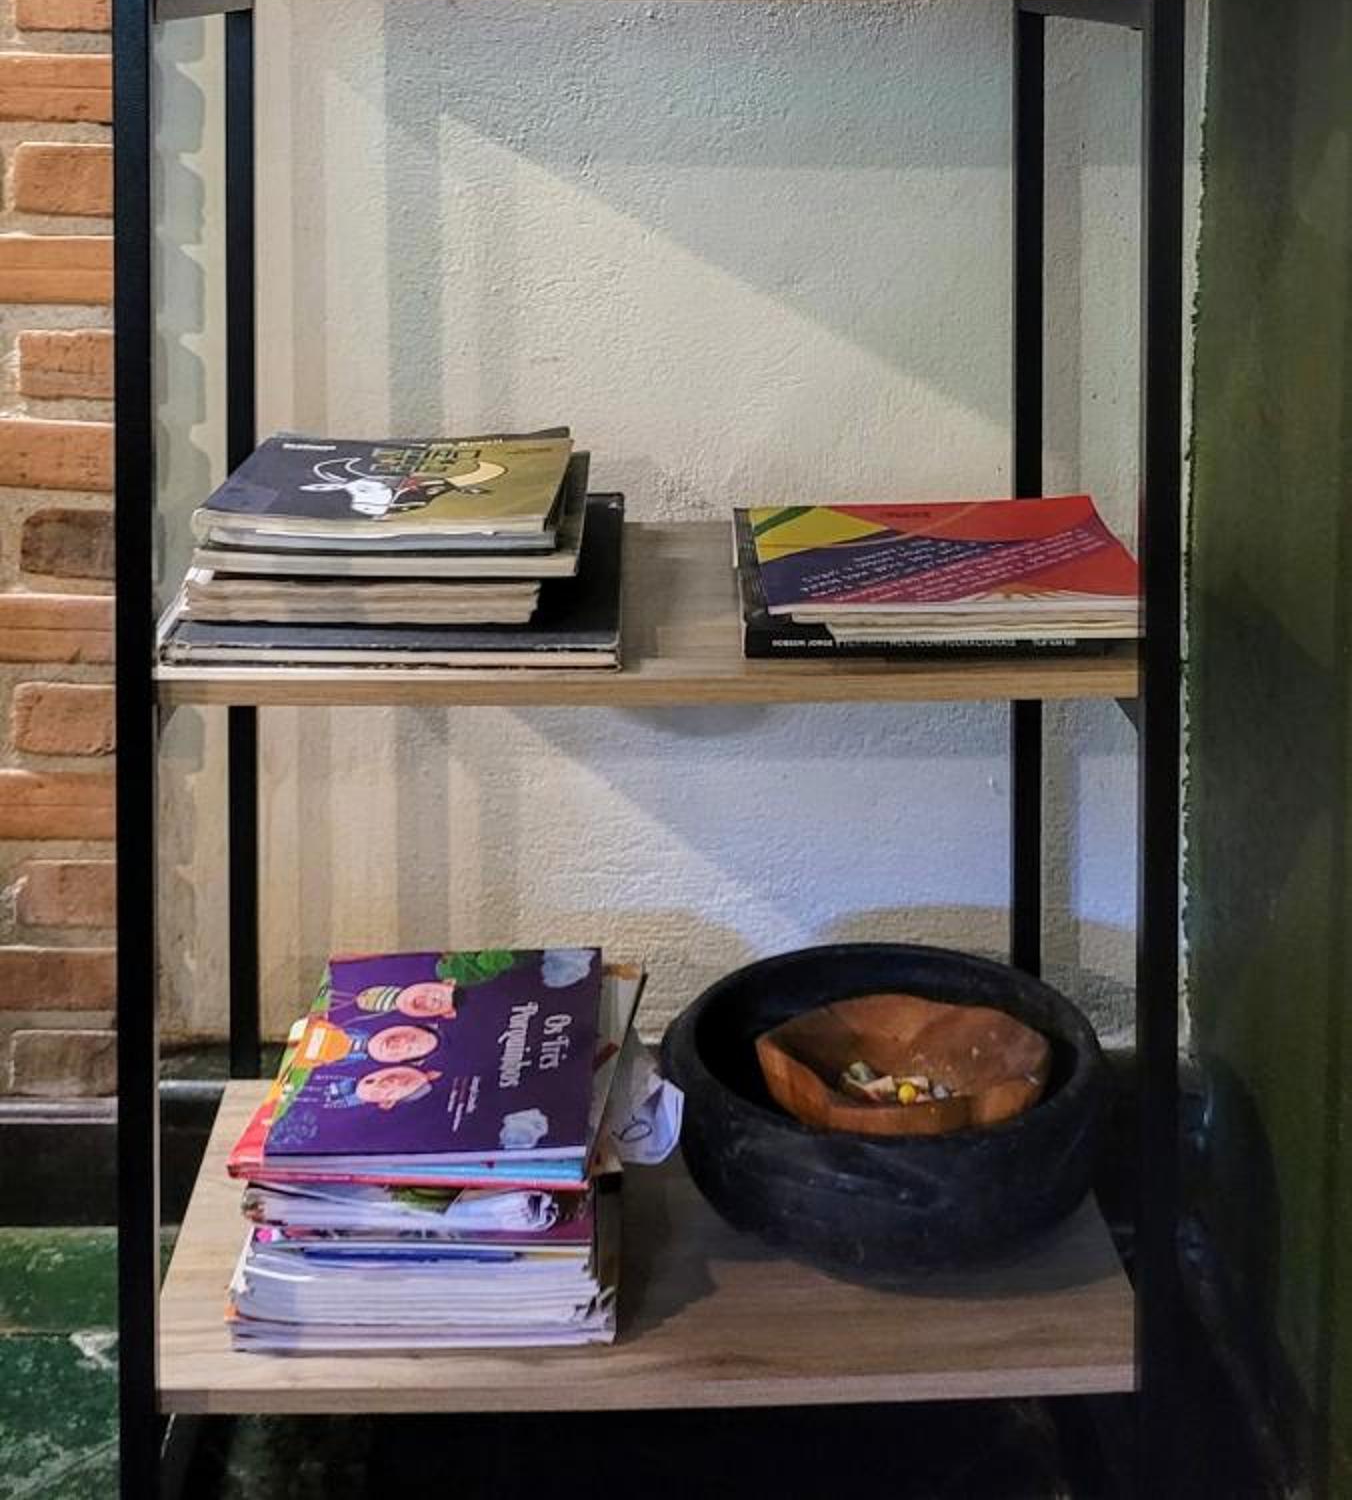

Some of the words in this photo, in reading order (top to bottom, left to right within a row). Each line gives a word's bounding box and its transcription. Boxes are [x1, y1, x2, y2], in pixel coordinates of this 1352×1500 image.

[808, 638, 833, 647] JORGE
[543, 1013, 573, 1035] Os
[497, 1001, 540, 1089] Porquinhos
